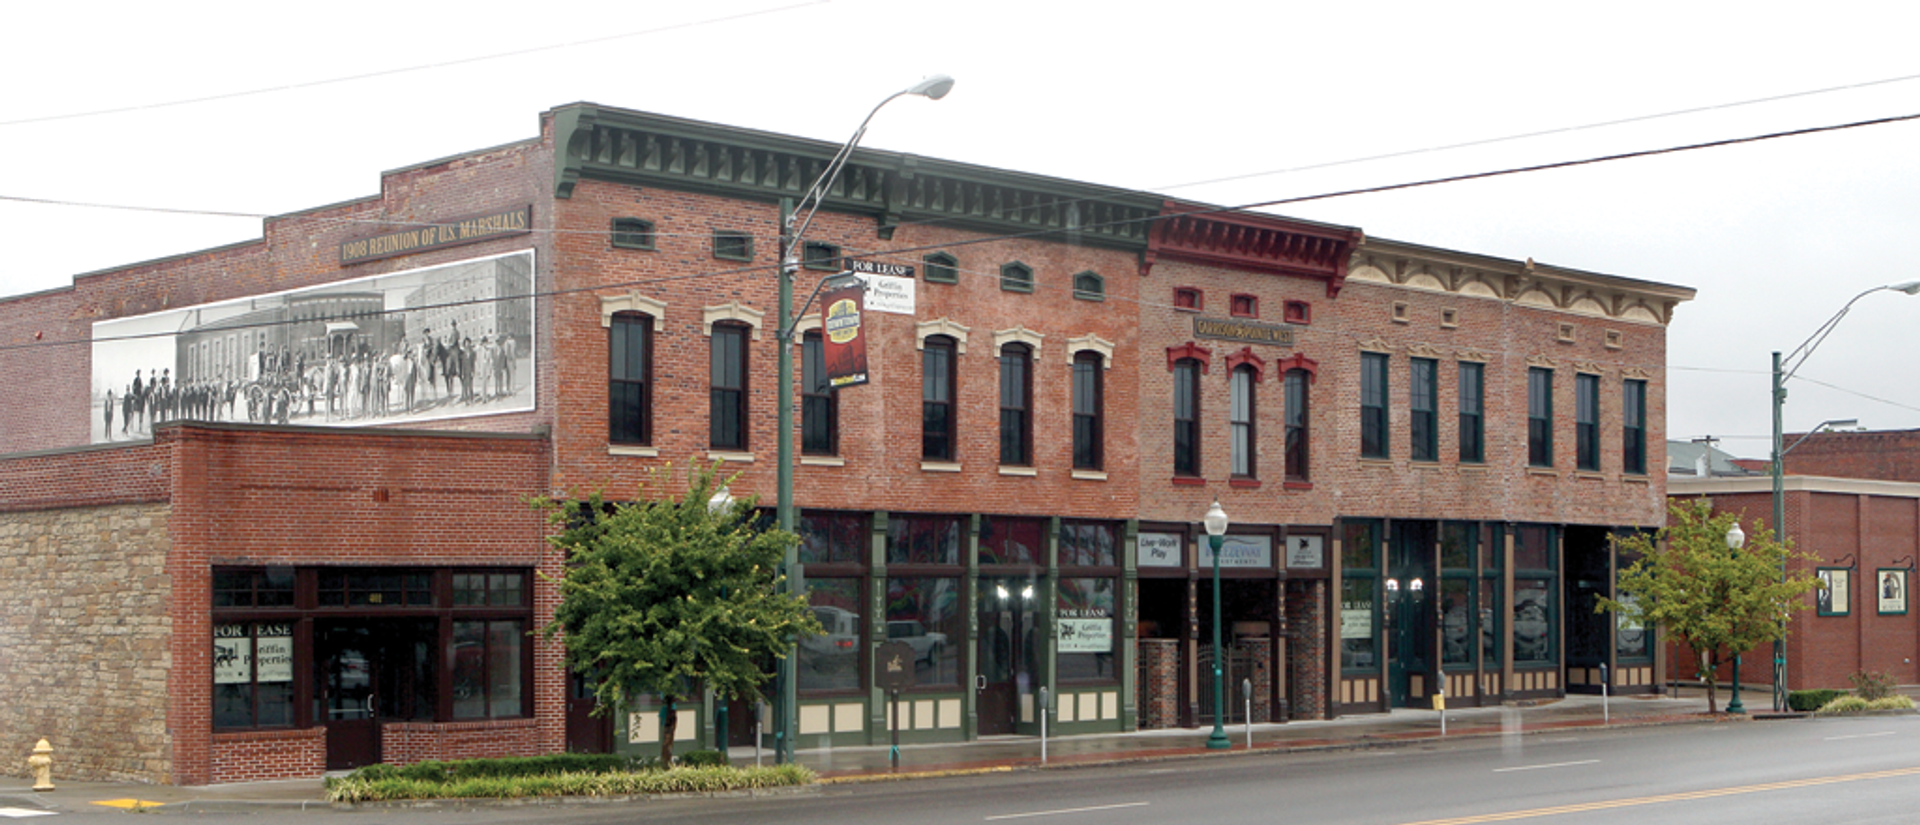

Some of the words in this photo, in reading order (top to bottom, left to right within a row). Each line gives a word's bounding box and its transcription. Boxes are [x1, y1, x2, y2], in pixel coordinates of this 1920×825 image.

[343, 239, 368, 260] 1908
[369, 229, 419, 254] REUNION
[421, 226, 435, 246] OF
[438, 223, 457, 243] U.S.
[459, 210, 525, 239] MARSHALS
[853, 260, 874, 272] FOR
[877, 264, 907, 275] LEASE
[257, 643, 287, 654] riffin
